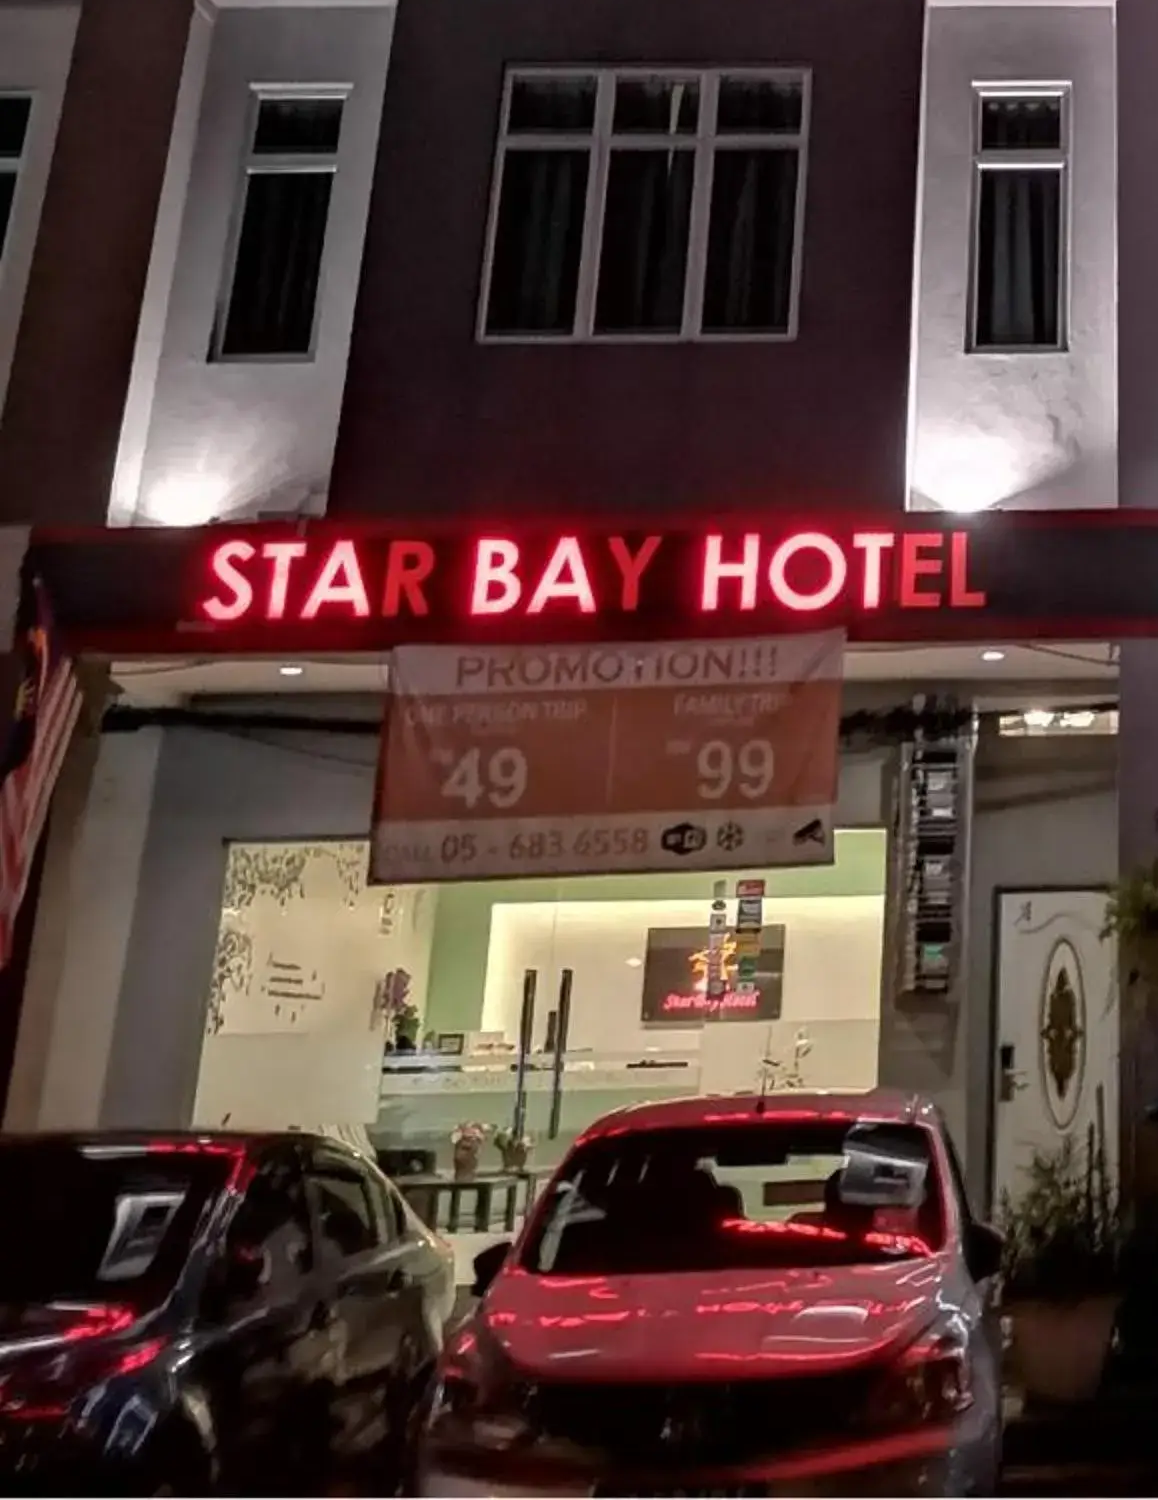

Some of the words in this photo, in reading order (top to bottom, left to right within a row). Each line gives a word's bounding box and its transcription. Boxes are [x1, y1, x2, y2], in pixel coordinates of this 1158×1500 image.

[202, 539, 435, 621] STAR
[470, 535, 663, 616] BAY
[701, 531, 987, 611] HOTEL
[440, 746, 528, 809] 49
[697, 739, 774, 799] 99
[440, 833, 478, 865] 05
[508, 831, 563, 861] 683
[572, 828, 650, 857] 6558
